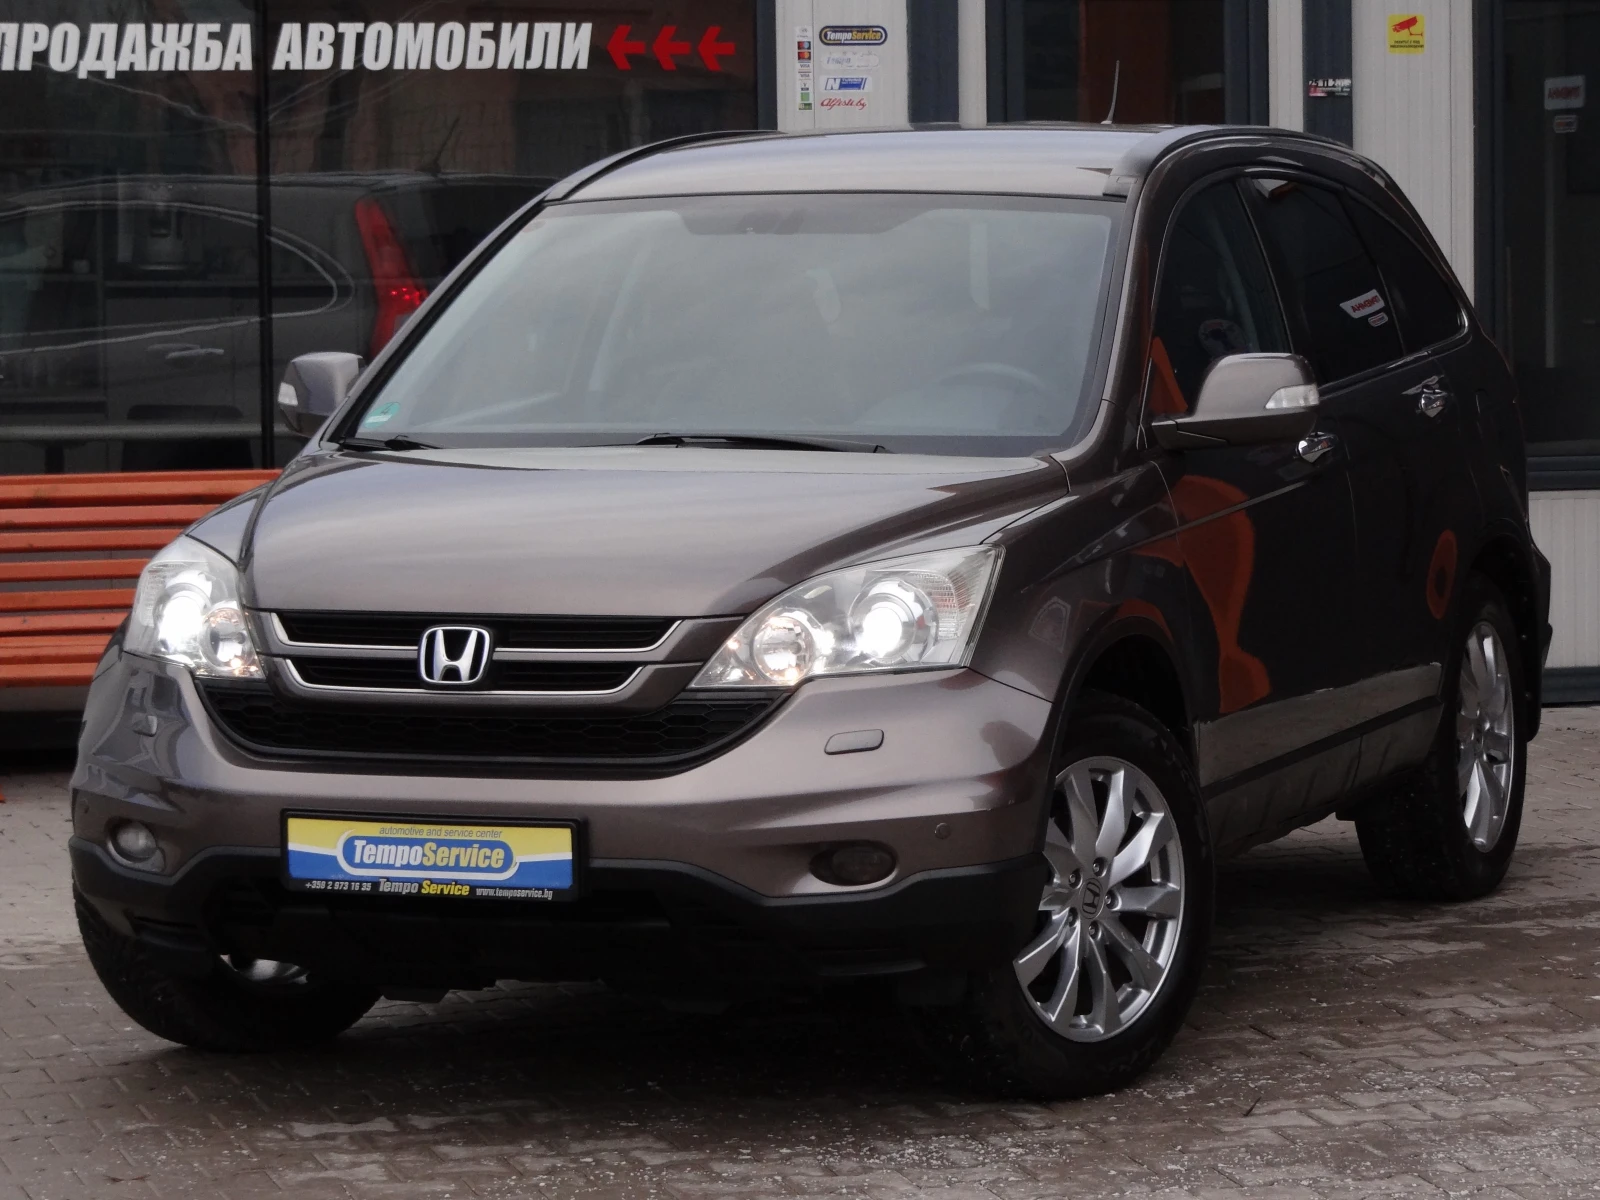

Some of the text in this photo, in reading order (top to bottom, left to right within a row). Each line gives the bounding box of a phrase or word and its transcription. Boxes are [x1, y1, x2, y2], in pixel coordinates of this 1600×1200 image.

[826, 30, 882, 43] TempoService
[0, 22, 593, 79] ПРОДАЖБА АВТОМОБИЛИ
[379, 826, 502, 838] automotive and service center
[353, 839, 504, 868] TempoService
[327, 881, 333, 890] 2
[334, 882, 349, 891] 973
[351, 882, 360, 891] 16
[361, 883, 372, 892] 35
[379, 878, 419, 895] Tempo
[421, 880, 470, 896] Service
[476, 887, 554, 900] www.temposervice.bg
